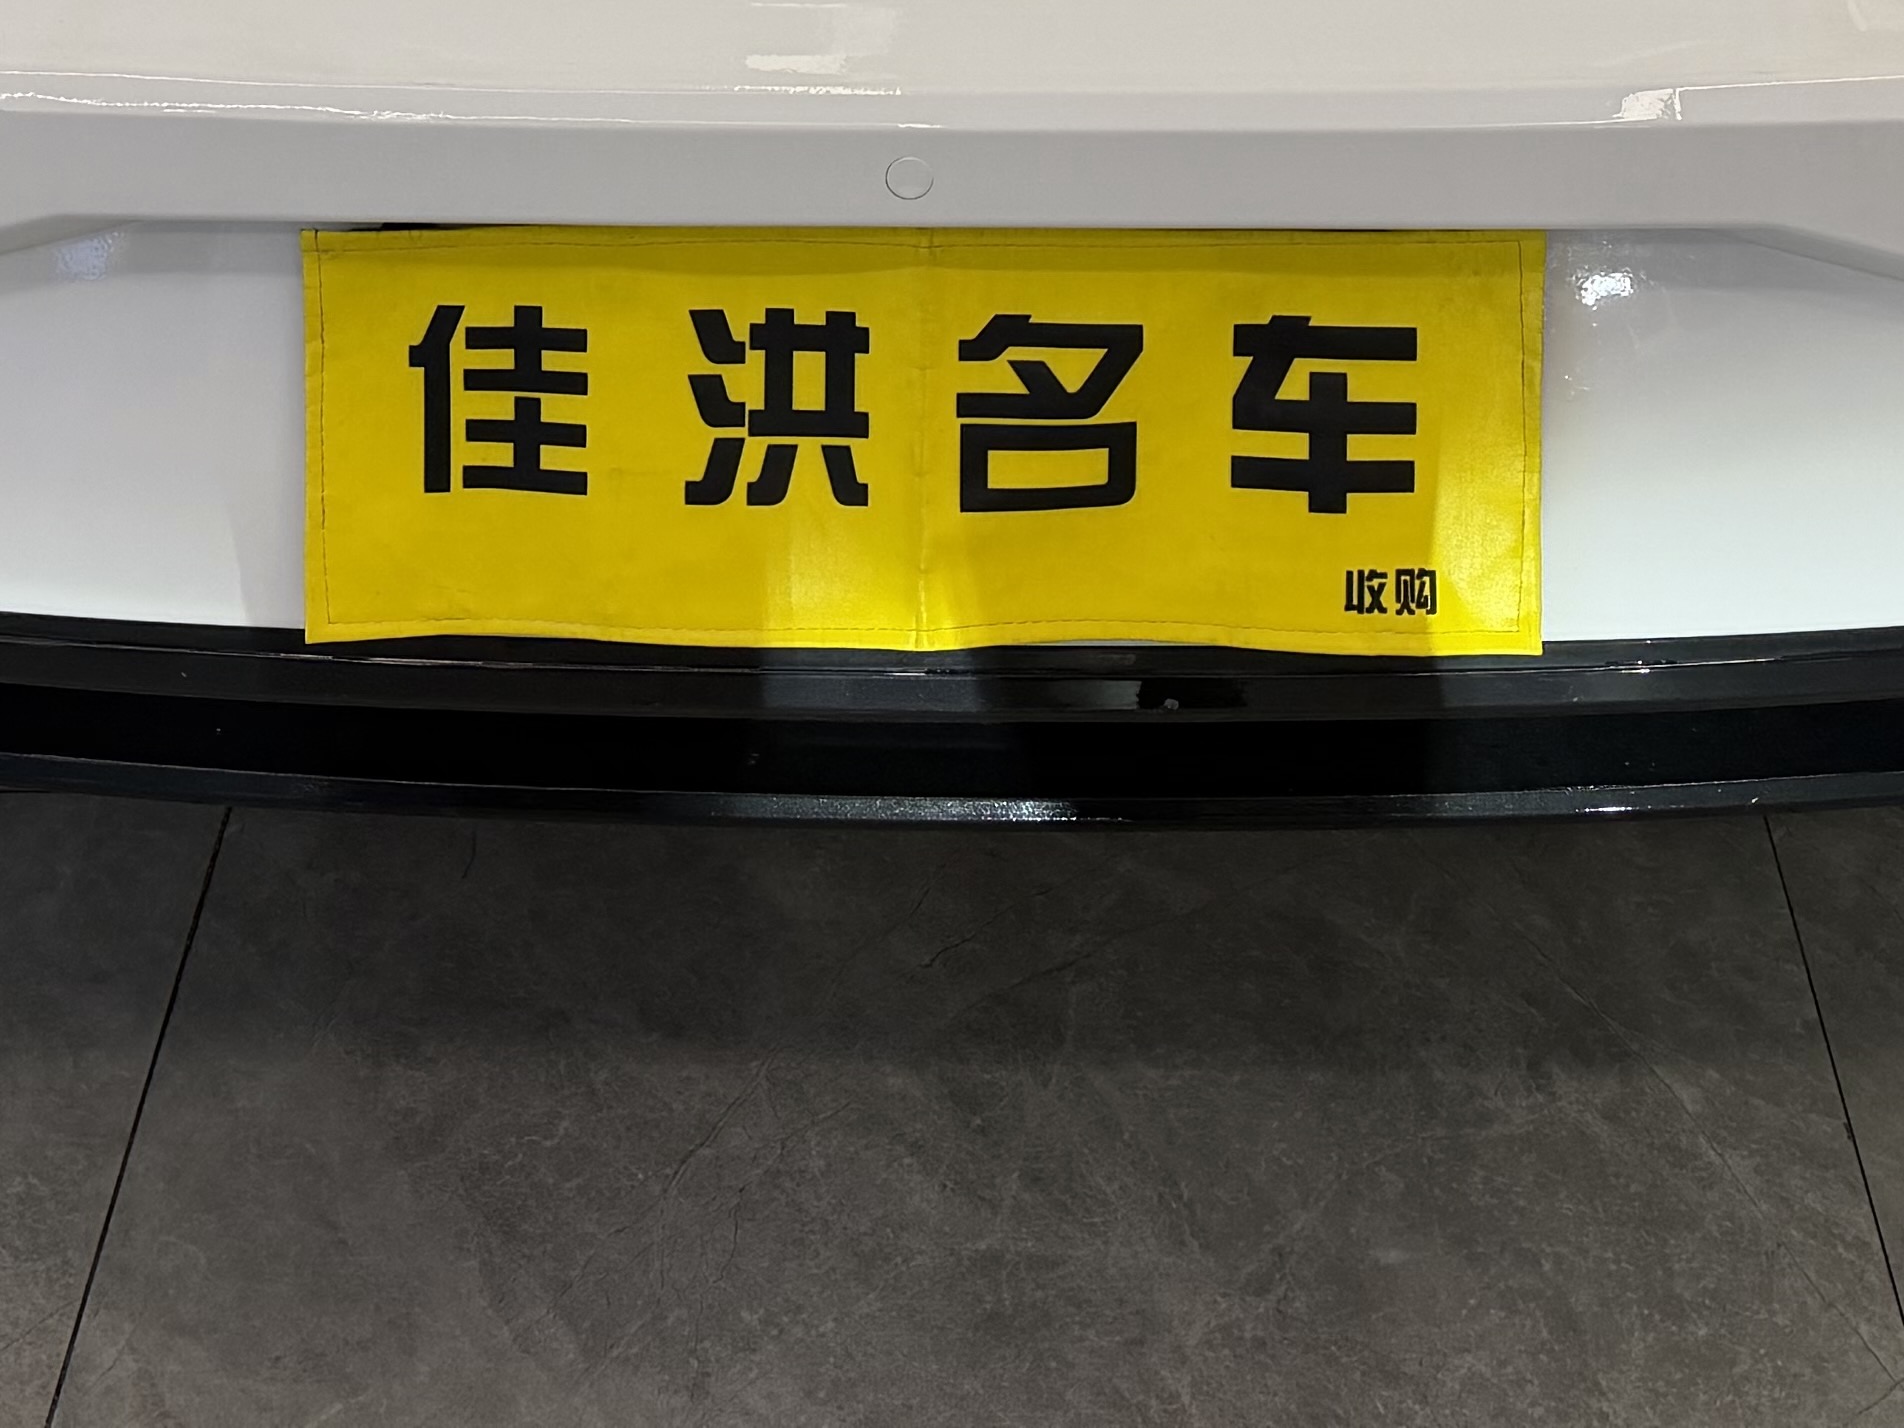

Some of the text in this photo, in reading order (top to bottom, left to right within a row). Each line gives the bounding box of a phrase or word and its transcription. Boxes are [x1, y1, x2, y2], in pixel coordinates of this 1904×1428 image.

[408, 304, 1419, 514] 佳洪名车
[1344, 568, 1437, 616] 收购
